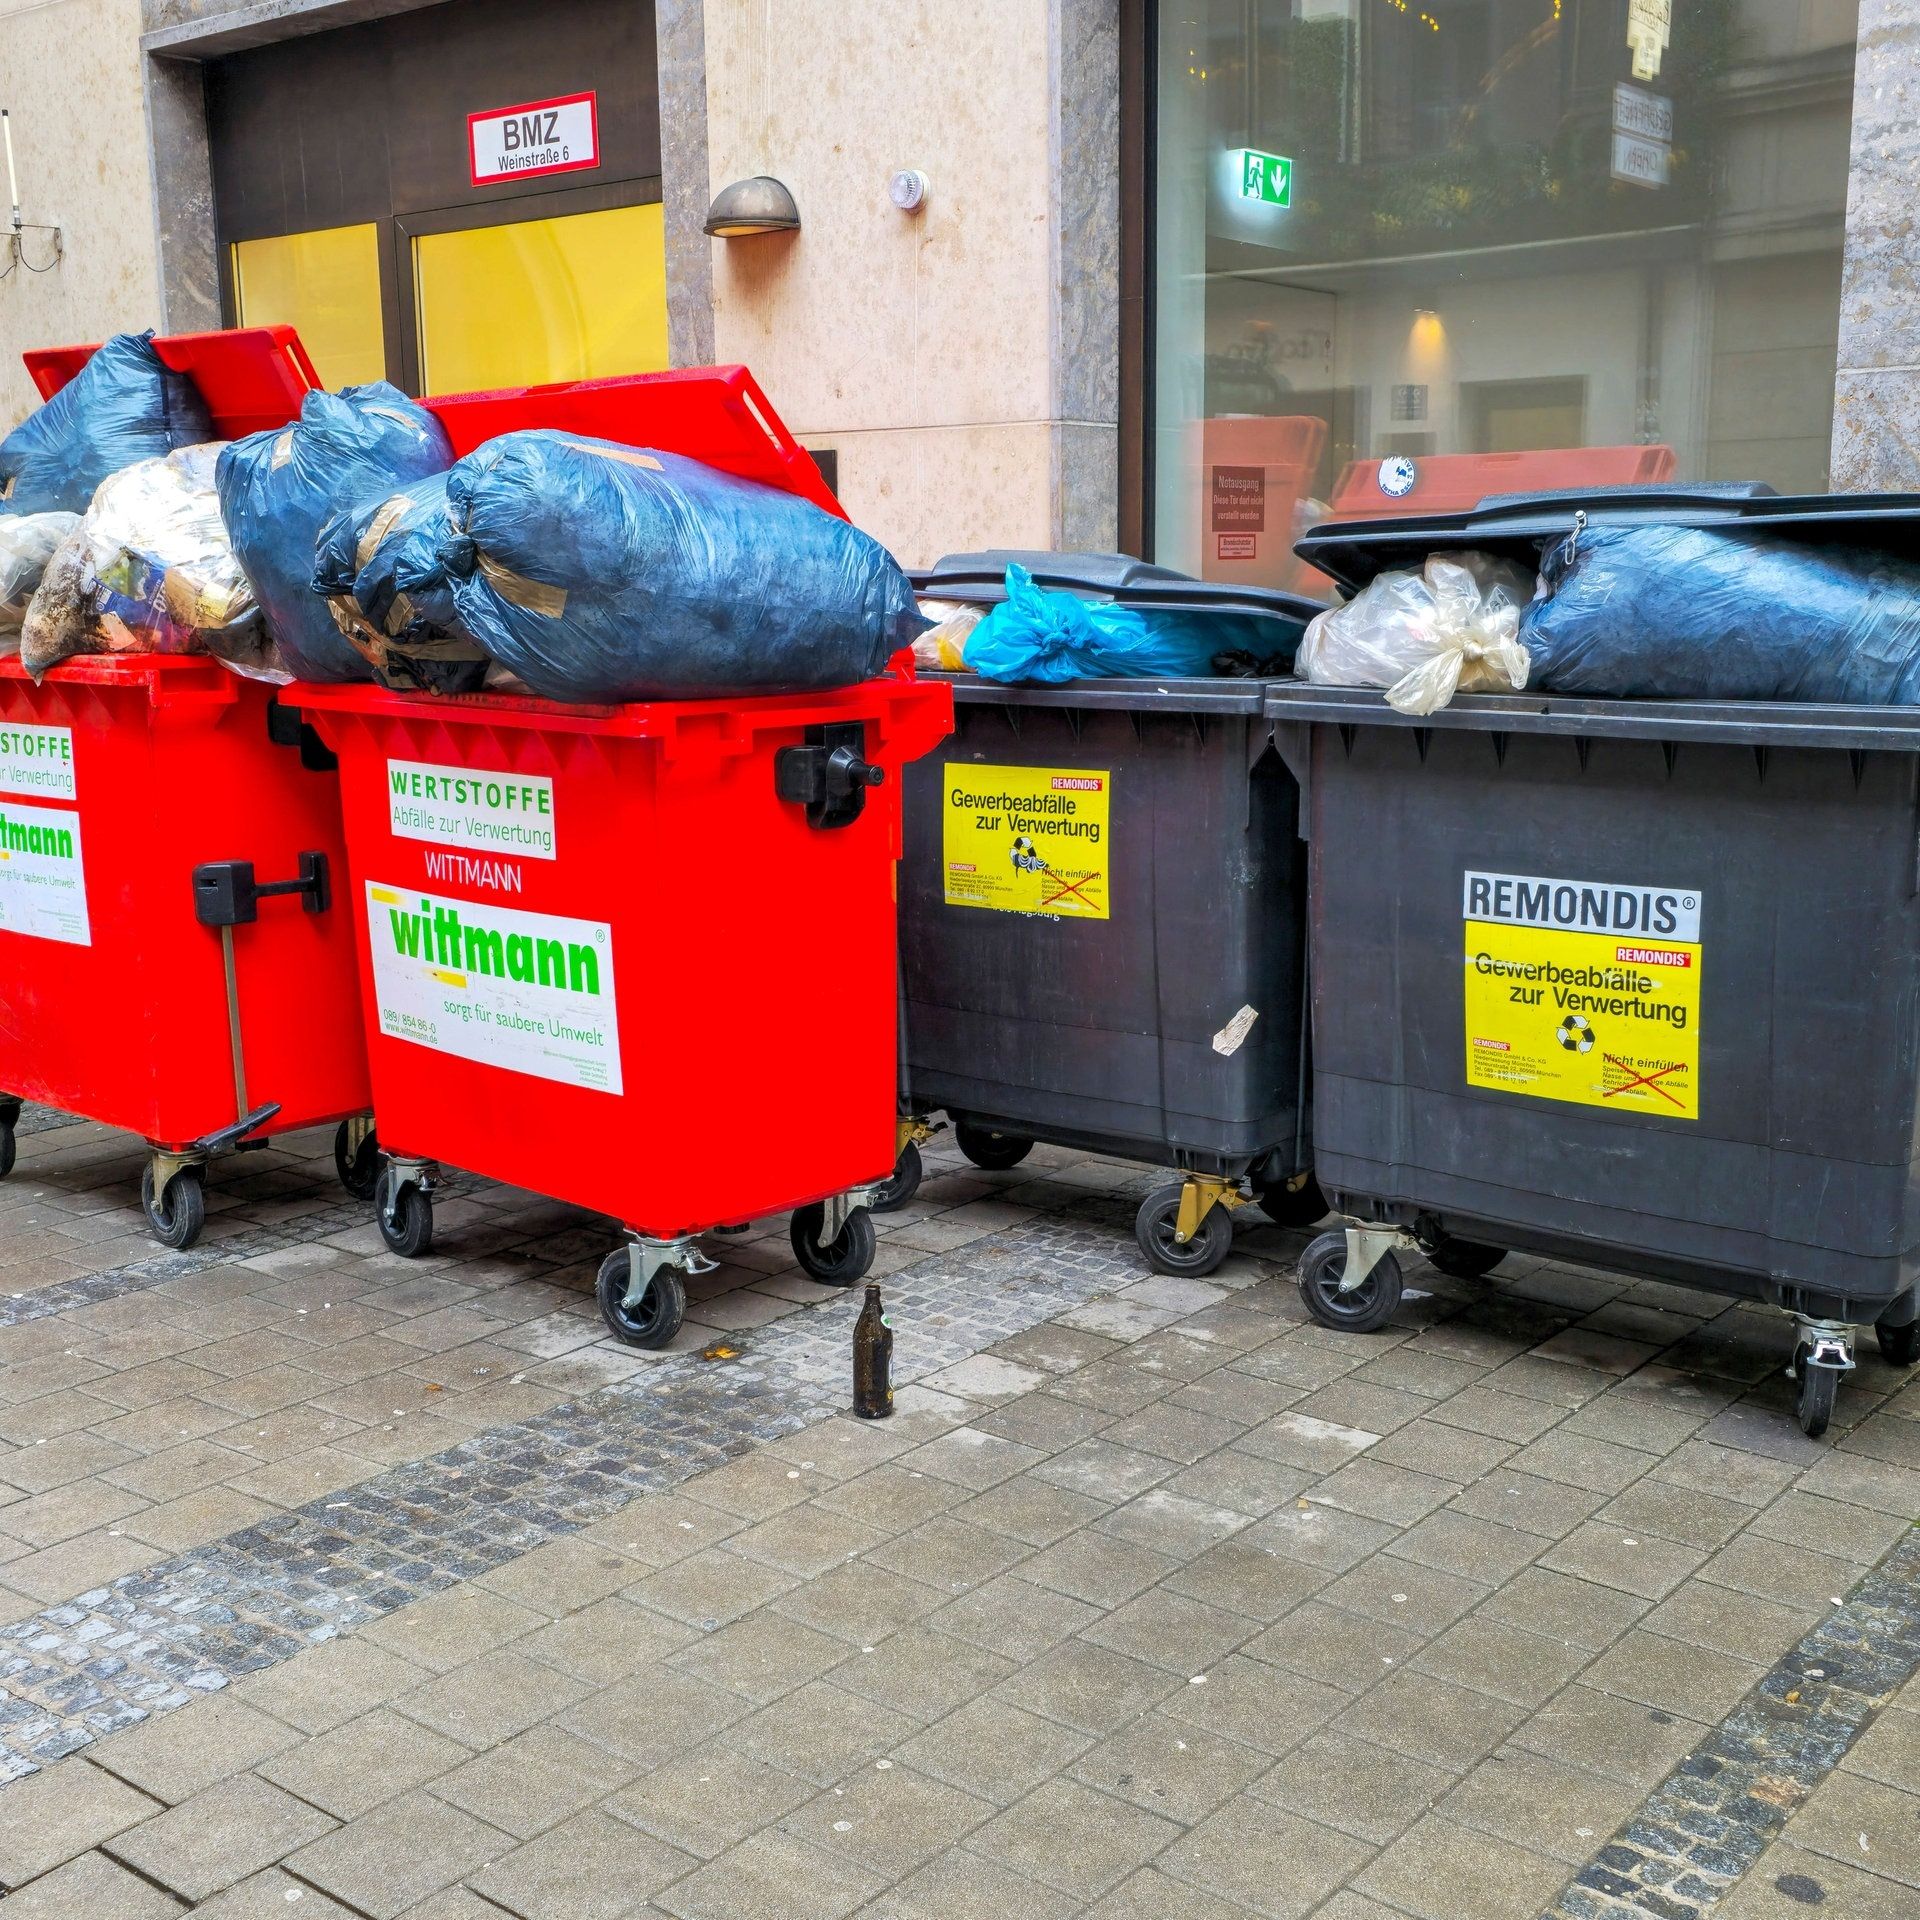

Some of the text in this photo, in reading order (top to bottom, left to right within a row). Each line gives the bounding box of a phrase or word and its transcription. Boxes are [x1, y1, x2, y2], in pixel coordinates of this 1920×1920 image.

[503, 111, 560, 151] BMZ
[498, 145, 570, 172] Weinstraße 6
[1218, 475, 1260, 492] Notausgang
[1213, 494, 1229, 504] Diese
[0, 732, 70, 759] STOFFE
[8, 765, 73, 792] Verwertung
[391, 770, 550, 814] WERTSTOFFE
[951, 789, 1076, 815] Gewerbeabfälle
[0, 813, 73, 859] tmann
[393, 806, 552, 852] Abfälle zur Verwertung
[976, 814, 1100, 843] zur Verwertung
[424, 850, 522, 894] WITTMANN
[1042, 866, 1102, 880] Nicht einfüllen
[1475, 952, 1652, 993] Gewerbeabfälle
[1509, 986, 1687, 1029] zur Verwertung
[444, 1000, 604, 1047] sorgt für saubere Umwelt
[1474, 1048, 1503, 1057] REMONDIS
[1603, 1053, 1688, 1073] Nicht einfüllen
[1665, 1080, 1688, 1088] Abfälle
